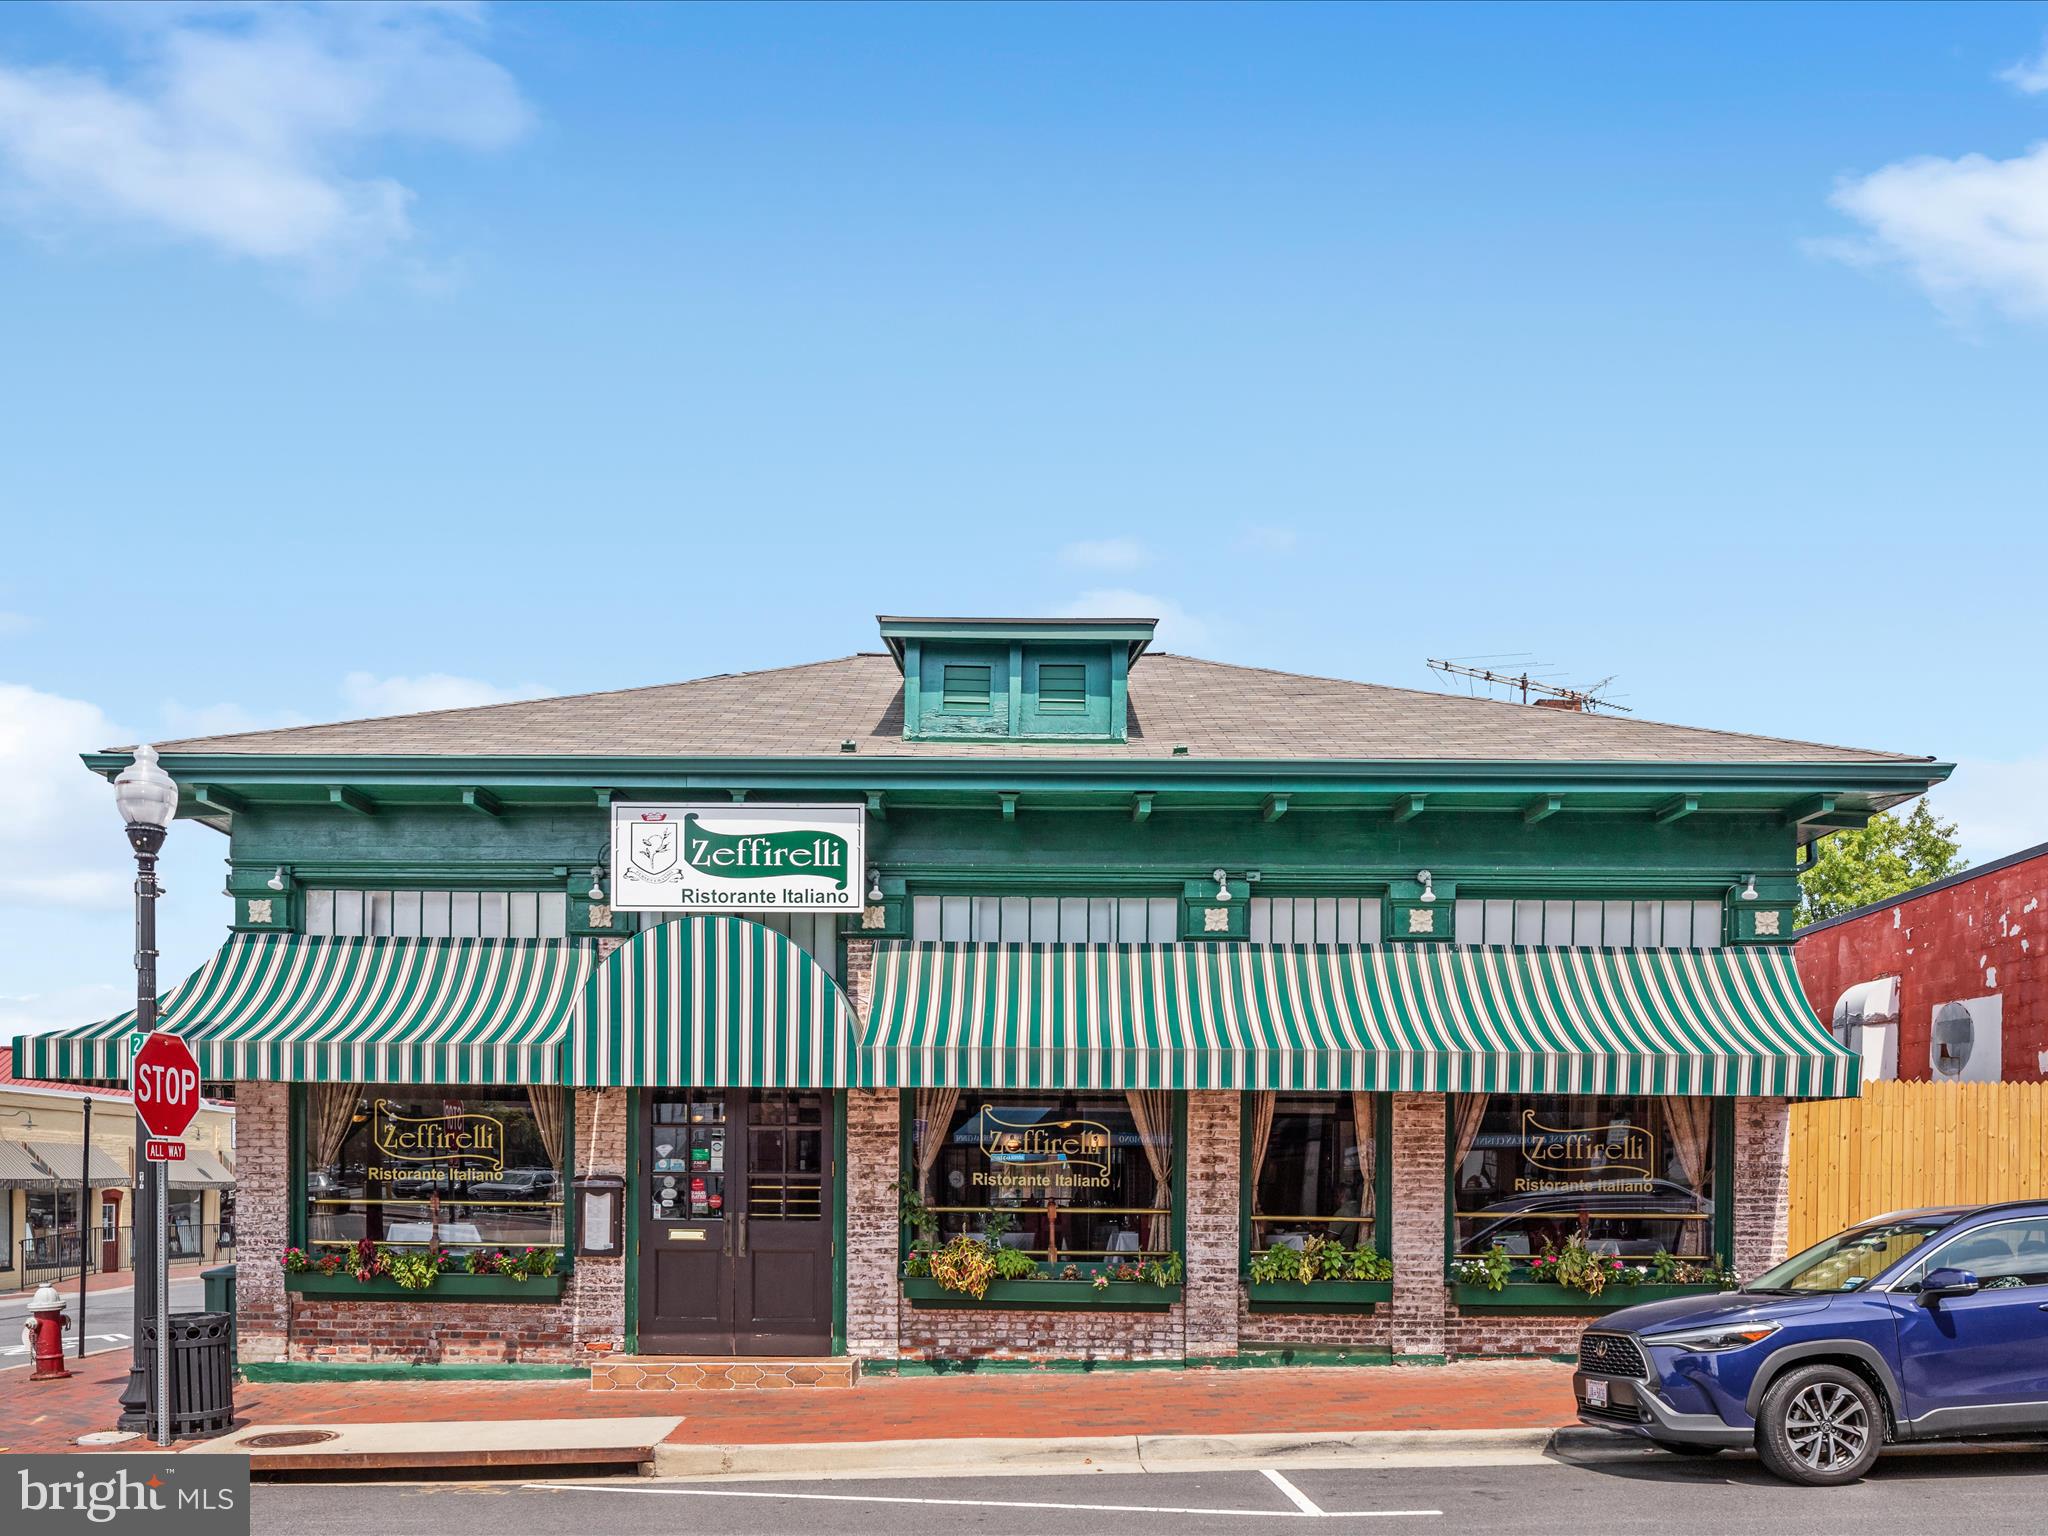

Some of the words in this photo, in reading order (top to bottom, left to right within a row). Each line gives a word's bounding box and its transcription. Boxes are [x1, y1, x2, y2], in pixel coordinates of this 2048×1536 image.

[691, 837, 841, 868] Zeffirelli
[682, 888, 776, 904] Ristorante
[783, 888, 849, 904] Italiano
[138, 1063, 196, 1106] STOP
[383, 1123, 494, 1150] Zeffirelli
[989, 1129, 1102, 1155] Zeffirelli
[150, 1145, 164, 1157] ALL
[168, 1145, 183, 1157] WAY
[1531, 1135, 1644, 1160] Zeffirelli
[368, 1167, 445, 1181] Ristorante
[450, 1167, 503, 1181] Italiano
[972, 1173, 1050, 1187] Ristorante
[1056, 1173, 1110, 1187] Italiano
[1515, 1178, 1592, 1192] Ristorante
[1598, 1178, 1653, 1192] Italiano
